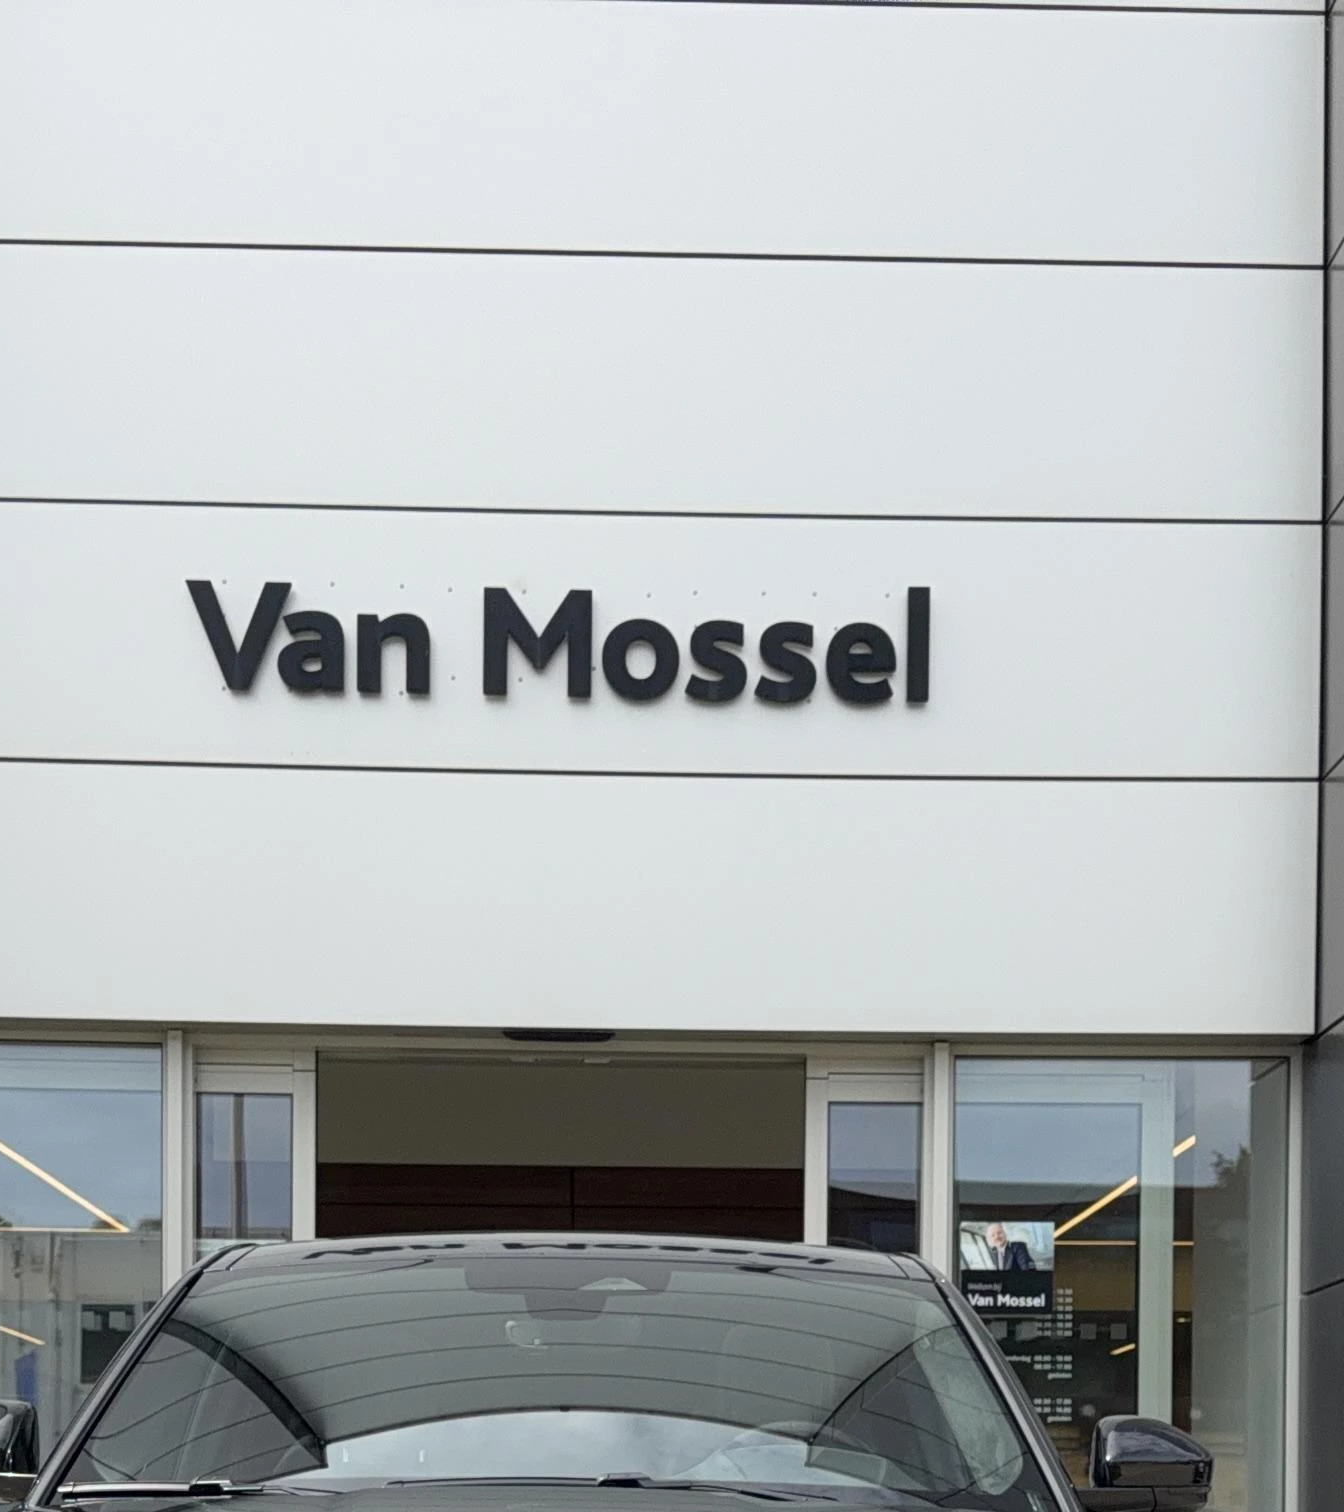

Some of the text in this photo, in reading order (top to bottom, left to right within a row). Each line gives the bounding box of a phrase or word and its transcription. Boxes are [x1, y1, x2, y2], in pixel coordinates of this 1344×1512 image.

[185, 579, 931, 704] Van Mossel
[967, 1293, 994, 1307] Van
[997, 1292, 1046, 1307] Mossel
